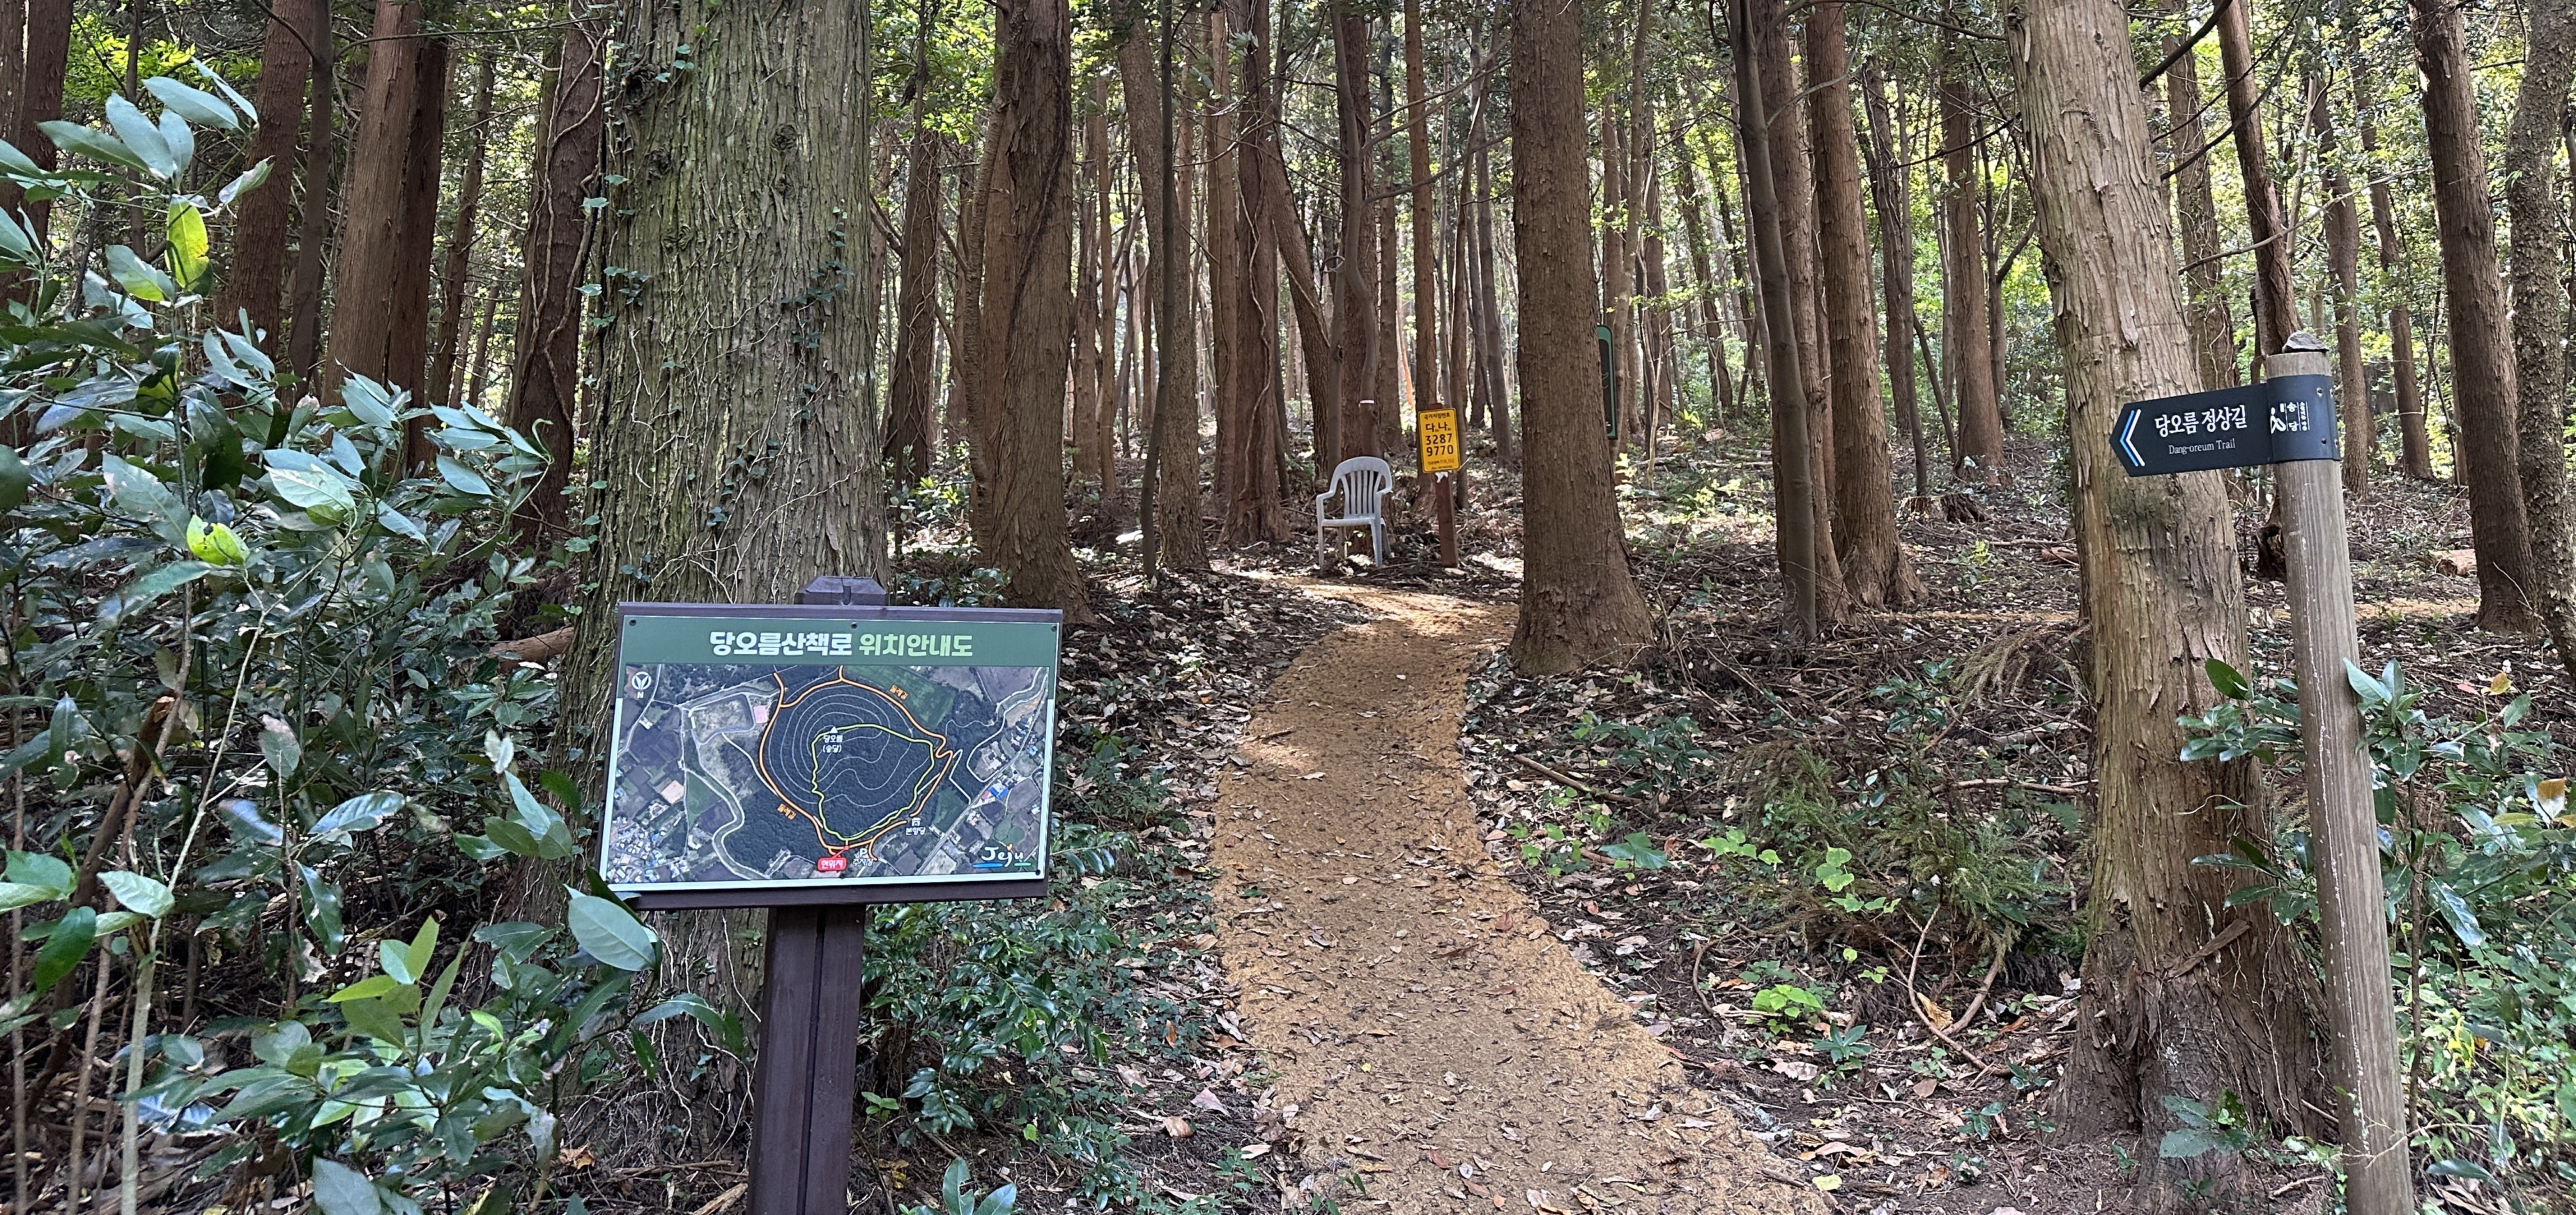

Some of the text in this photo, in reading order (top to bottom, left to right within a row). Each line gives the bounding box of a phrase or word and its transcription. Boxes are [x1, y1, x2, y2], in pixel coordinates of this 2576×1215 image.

[2154, 404, 2248, 438] 당오름 정상길
[1425, 433, 1452, 445] 3287
[1427, 445, 1453, 456] 9770
[2168, 438, 2235, 454] Dang-oreum Trail
[710, 632, 973, 657] 당오름산책로 위치안내도
[824, 735, 843, 743] 당오름
[823, 744, 842, 753] (송당)
[981, 846, 1024, 867] Jeju
[820, 859, 843, 869] 현위치
[853, 858, 873, 867] 주차장
